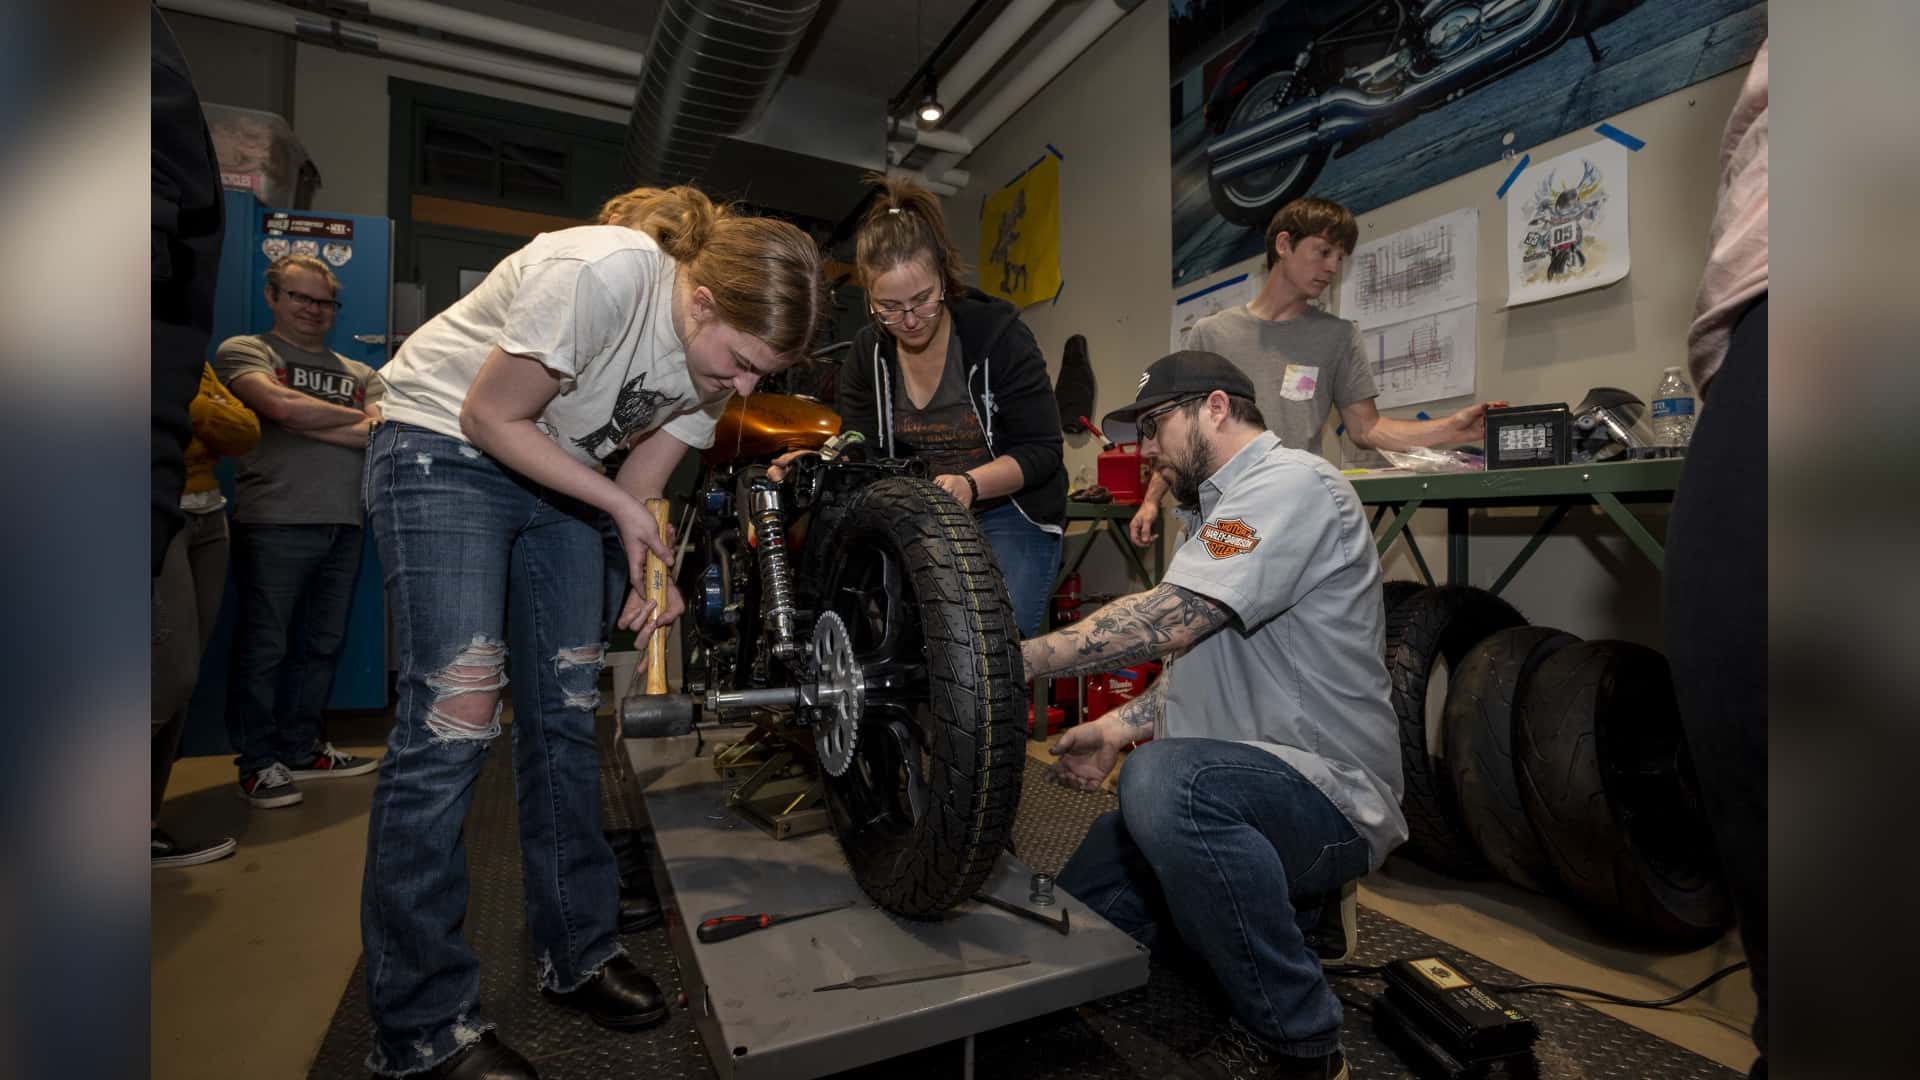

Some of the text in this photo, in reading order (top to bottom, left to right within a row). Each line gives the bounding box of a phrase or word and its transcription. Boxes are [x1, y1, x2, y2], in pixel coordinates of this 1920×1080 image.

[293, 367, 355, 396] BUILD
[1204, 527, 1254, 548] HARLEY-DAVIDSON
[1220, 522, 1250, 537] MOTOR
